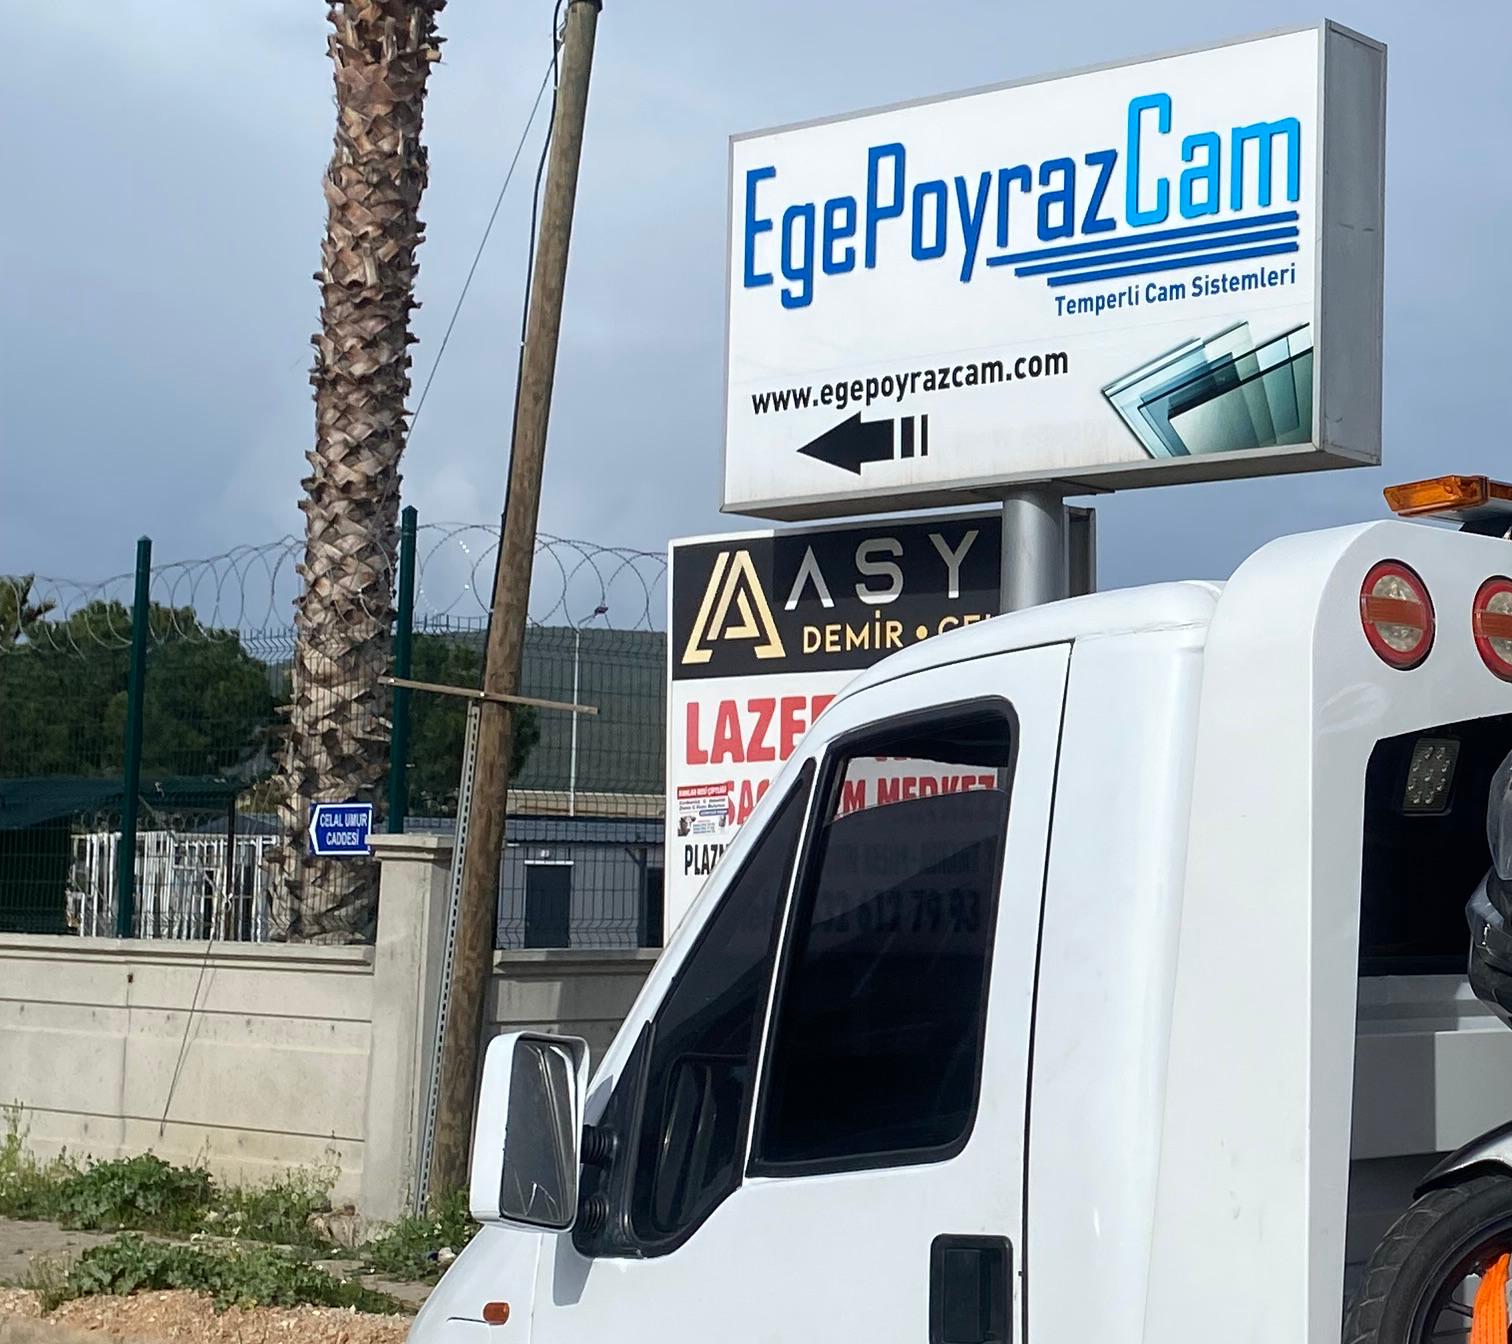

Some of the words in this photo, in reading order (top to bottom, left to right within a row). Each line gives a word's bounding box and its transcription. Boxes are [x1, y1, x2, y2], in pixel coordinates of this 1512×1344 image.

[743, 93, 1300, 309] EgePoyrazCam
[1054, 284, 1140, 317] Temperli
[1145, 282, 1186, 304] Cam
[1191, 262, 1296, 298] Sistemleri
[751, 350, 1069, 415] www.egepoyrazcam.com
[803, 610, 904, 654] DEMİR
[319, 813, 344, 828] CELAL
[344, 812, 368, 828] UMUR
[325, 828, 360, 846] CADDESİ
